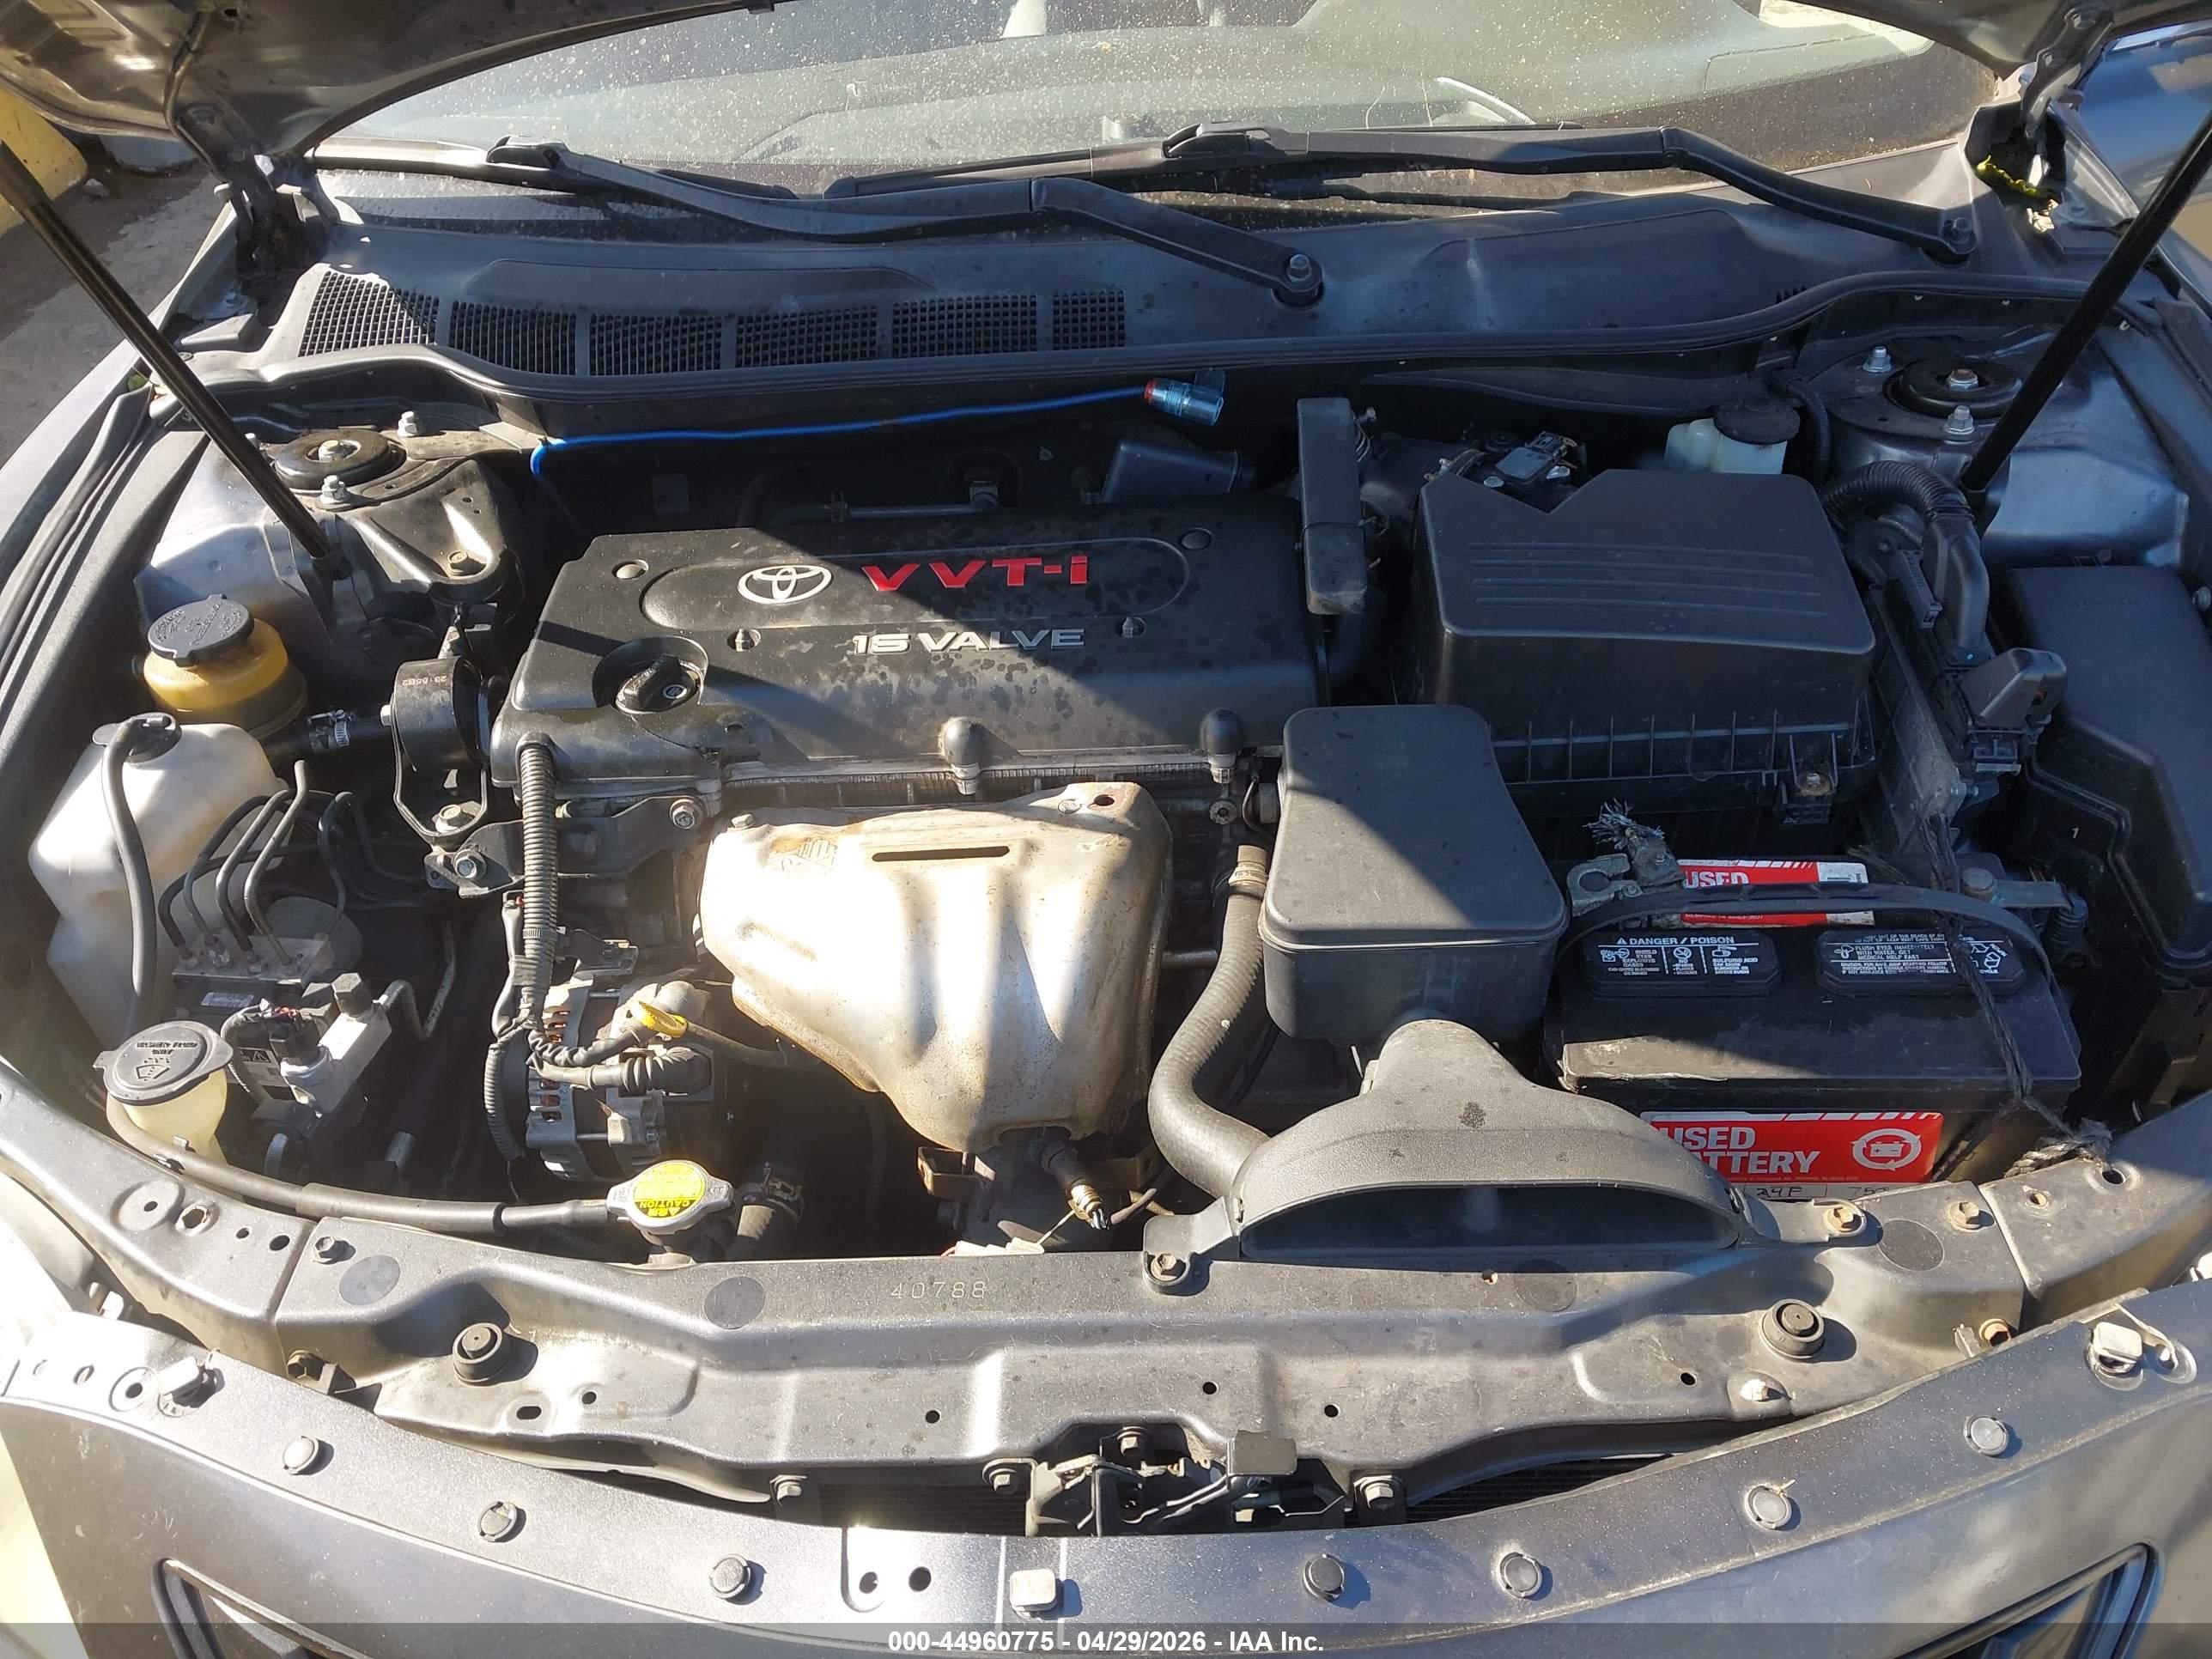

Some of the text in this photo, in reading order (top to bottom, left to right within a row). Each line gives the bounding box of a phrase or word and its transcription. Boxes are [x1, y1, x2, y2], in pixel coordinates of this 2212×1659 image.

[861, 556, 1088, 591] VVT-i
[852, 628, 1085, 655] 16 VALVE
[1682, 871, 1750, 890] USED
[1629, 937, 1678, 945] DANGER
[1690, 936, 1735, 945] POISON
[1693, 1151, 1821, 1175] TTERY
[638, 1199, 691, 1209] CAUTION
[890, 1280, 988, 1299] 40788
